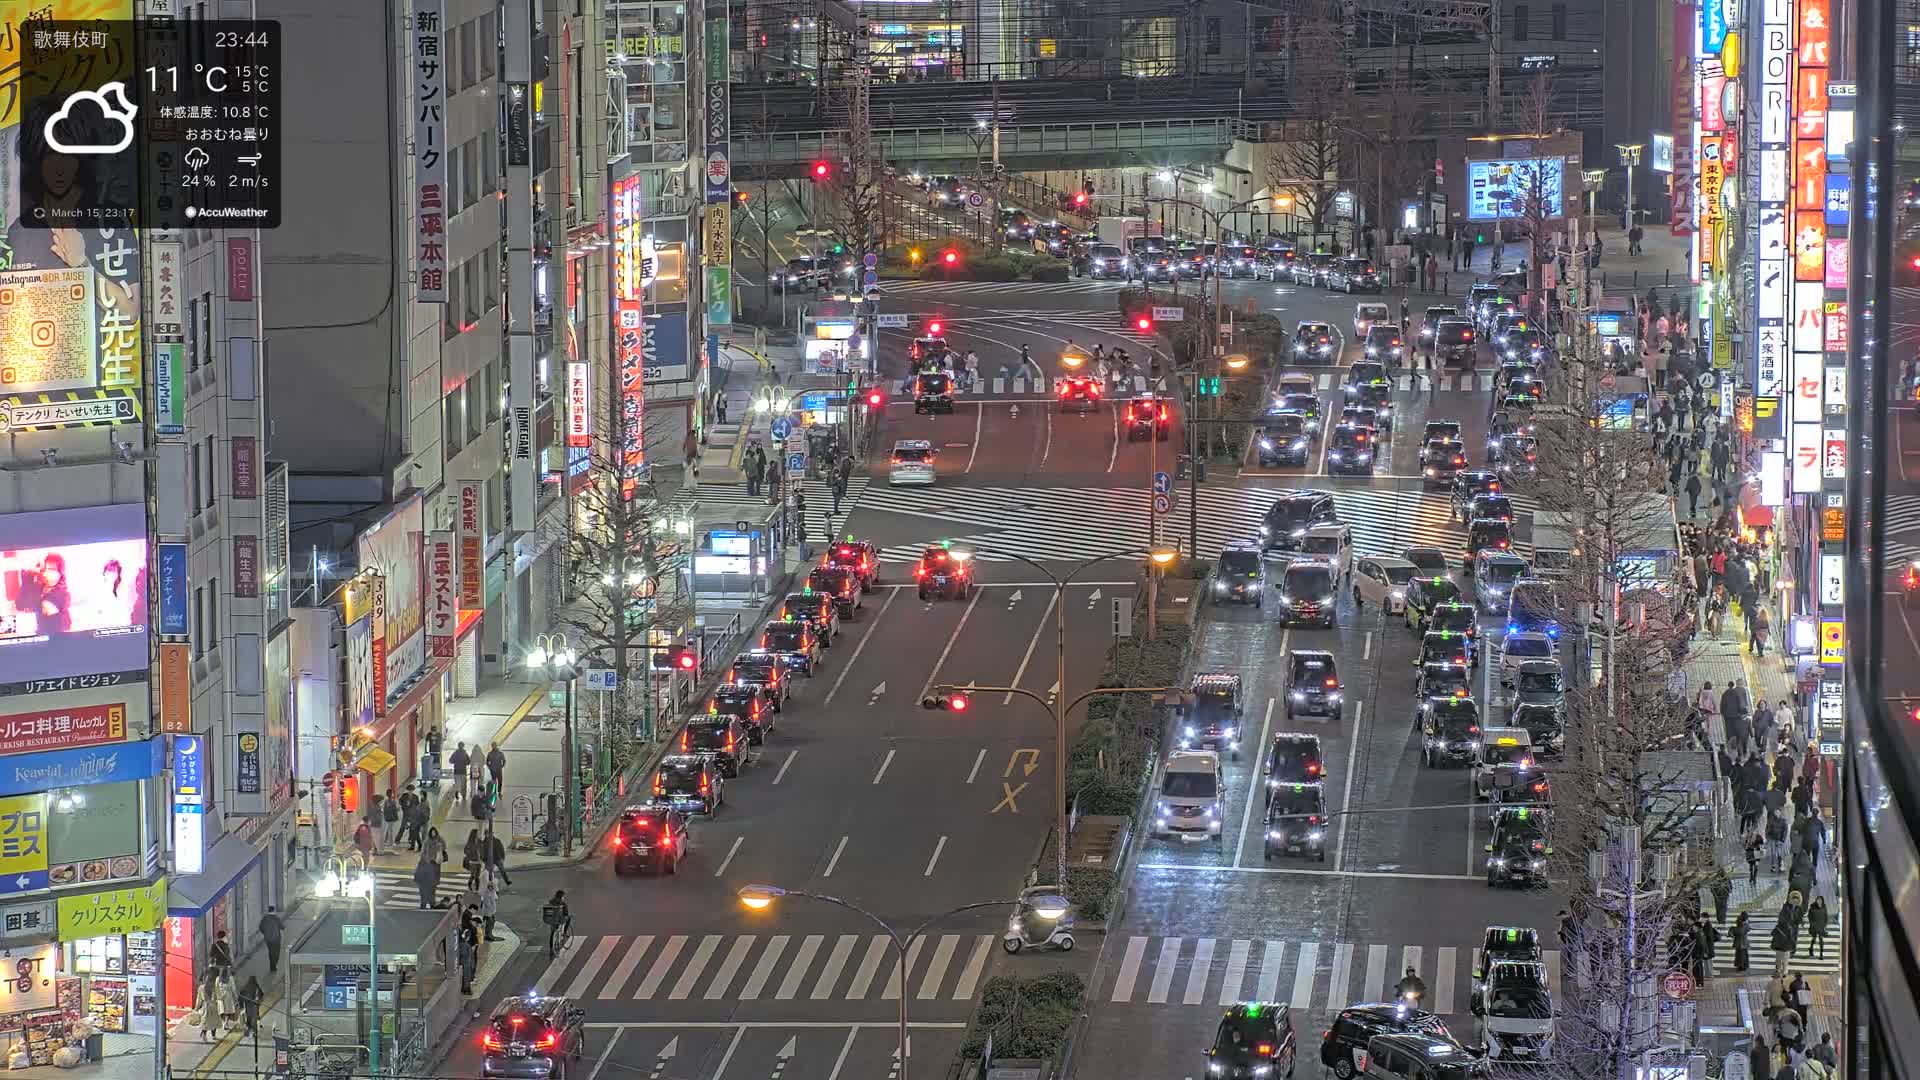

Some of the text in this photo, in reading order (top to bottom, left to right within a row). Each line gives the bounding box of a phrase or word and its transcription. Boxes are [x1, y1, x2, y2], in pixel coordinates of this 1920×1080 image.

[417, 11, 440, 169] 新宿サンパーク
[420, 184, 443, 290] 三平本館
[160, 324, 176, 333] 3F
[1761, 330, 1774, 382] 大衆酒場
[159, 354, 170, 414] FamilyMart
[15, 404, 113, 421] テンクリ たいせい先生
[516, 407, 529, 459] HOMEGAME
[462, 487, 473, 531] GAME
[435, 542, 450, 628] 三平ストア
[375, 580, 383, 619] 389
[26, 674, 121, 693] リアエイド ビジョン
[112, 711, 121, 735] 5F
[167, 722, 183, 730] B2
[2, 812, 41, 835] プロ
[3, 837, 41, 860] ミス
[6, 911, 41, 931] 囲碁
[72, 903, 144, 927] クリスタル
[328, 991, 344, 1003] 12
